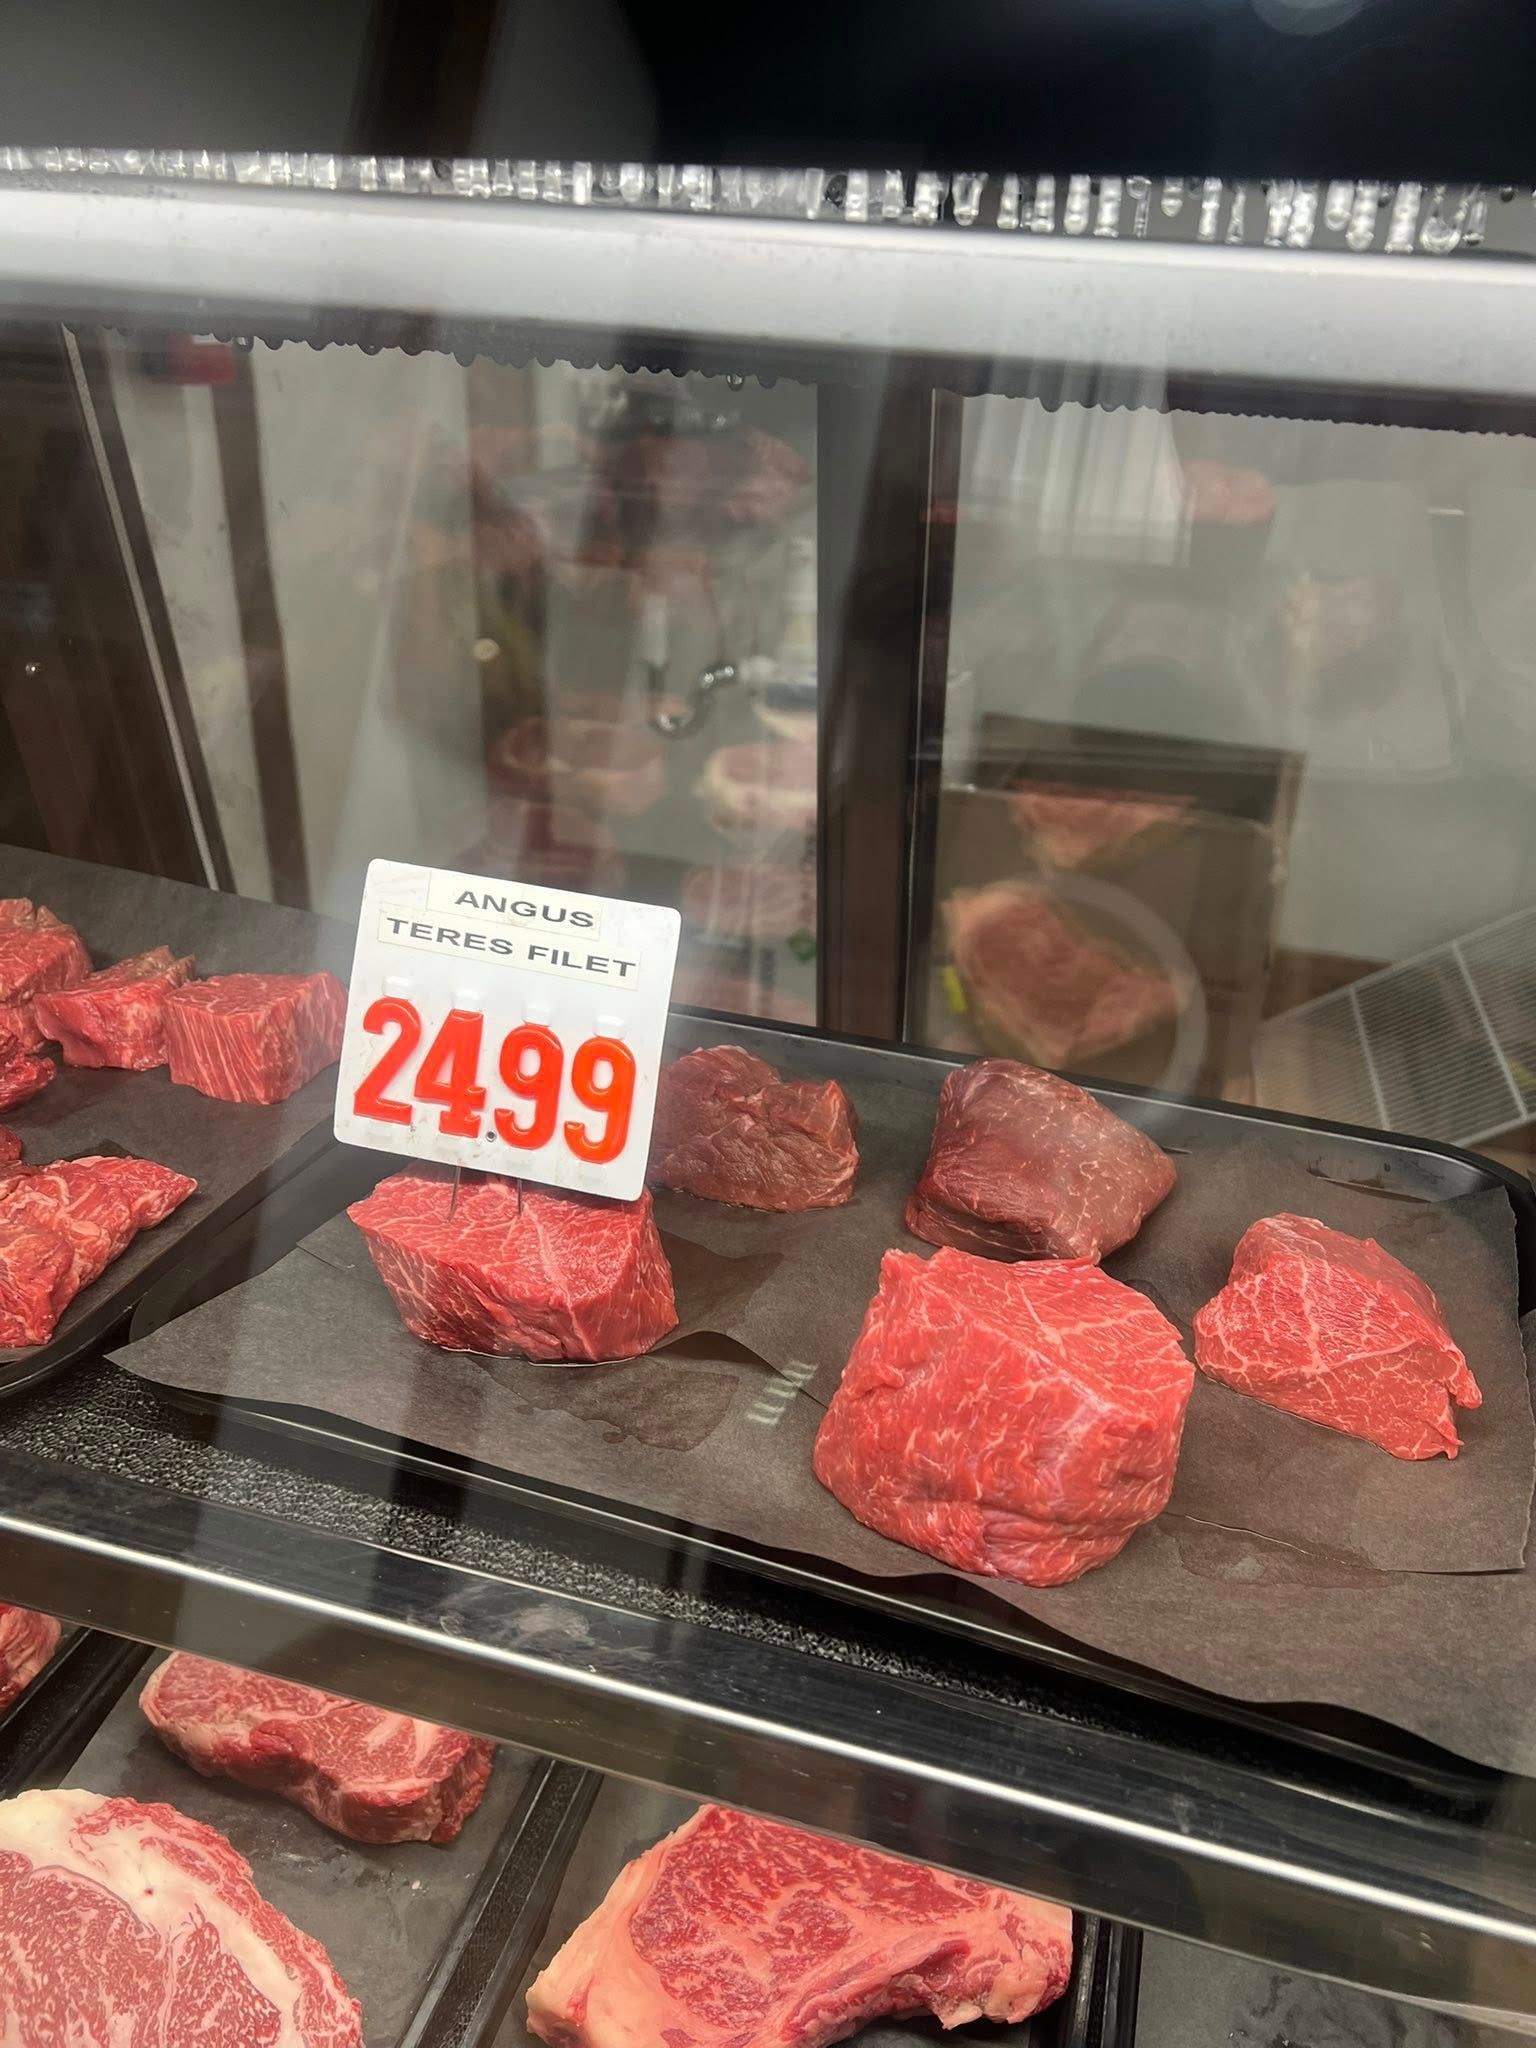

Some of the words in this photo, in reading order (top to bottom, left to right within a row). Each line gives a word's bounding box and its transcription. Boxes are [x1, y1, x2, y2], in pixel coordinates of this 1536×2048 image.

[454, 890, 595, 928] ANGUS
[386, 917, 514, 956] TERES
[526, 945, 636, 978] FILET
